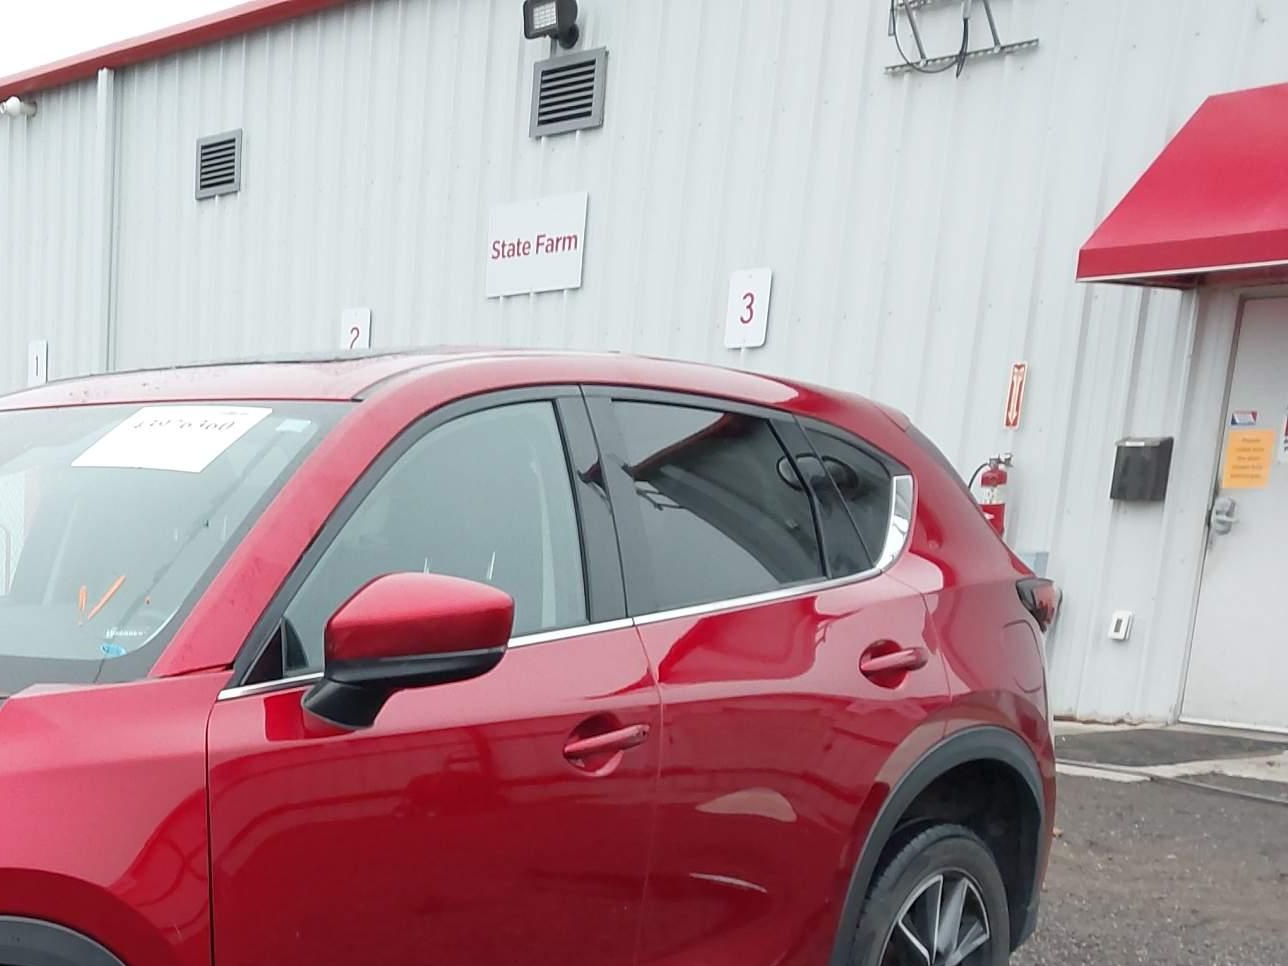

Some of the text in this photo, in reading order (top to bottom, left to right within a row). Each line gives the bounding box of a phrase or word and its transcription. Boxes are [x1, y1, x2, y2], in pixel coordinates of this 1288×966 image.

[491, 233, 578, 260] State Farm
[740, 292, 755, 324] 3
